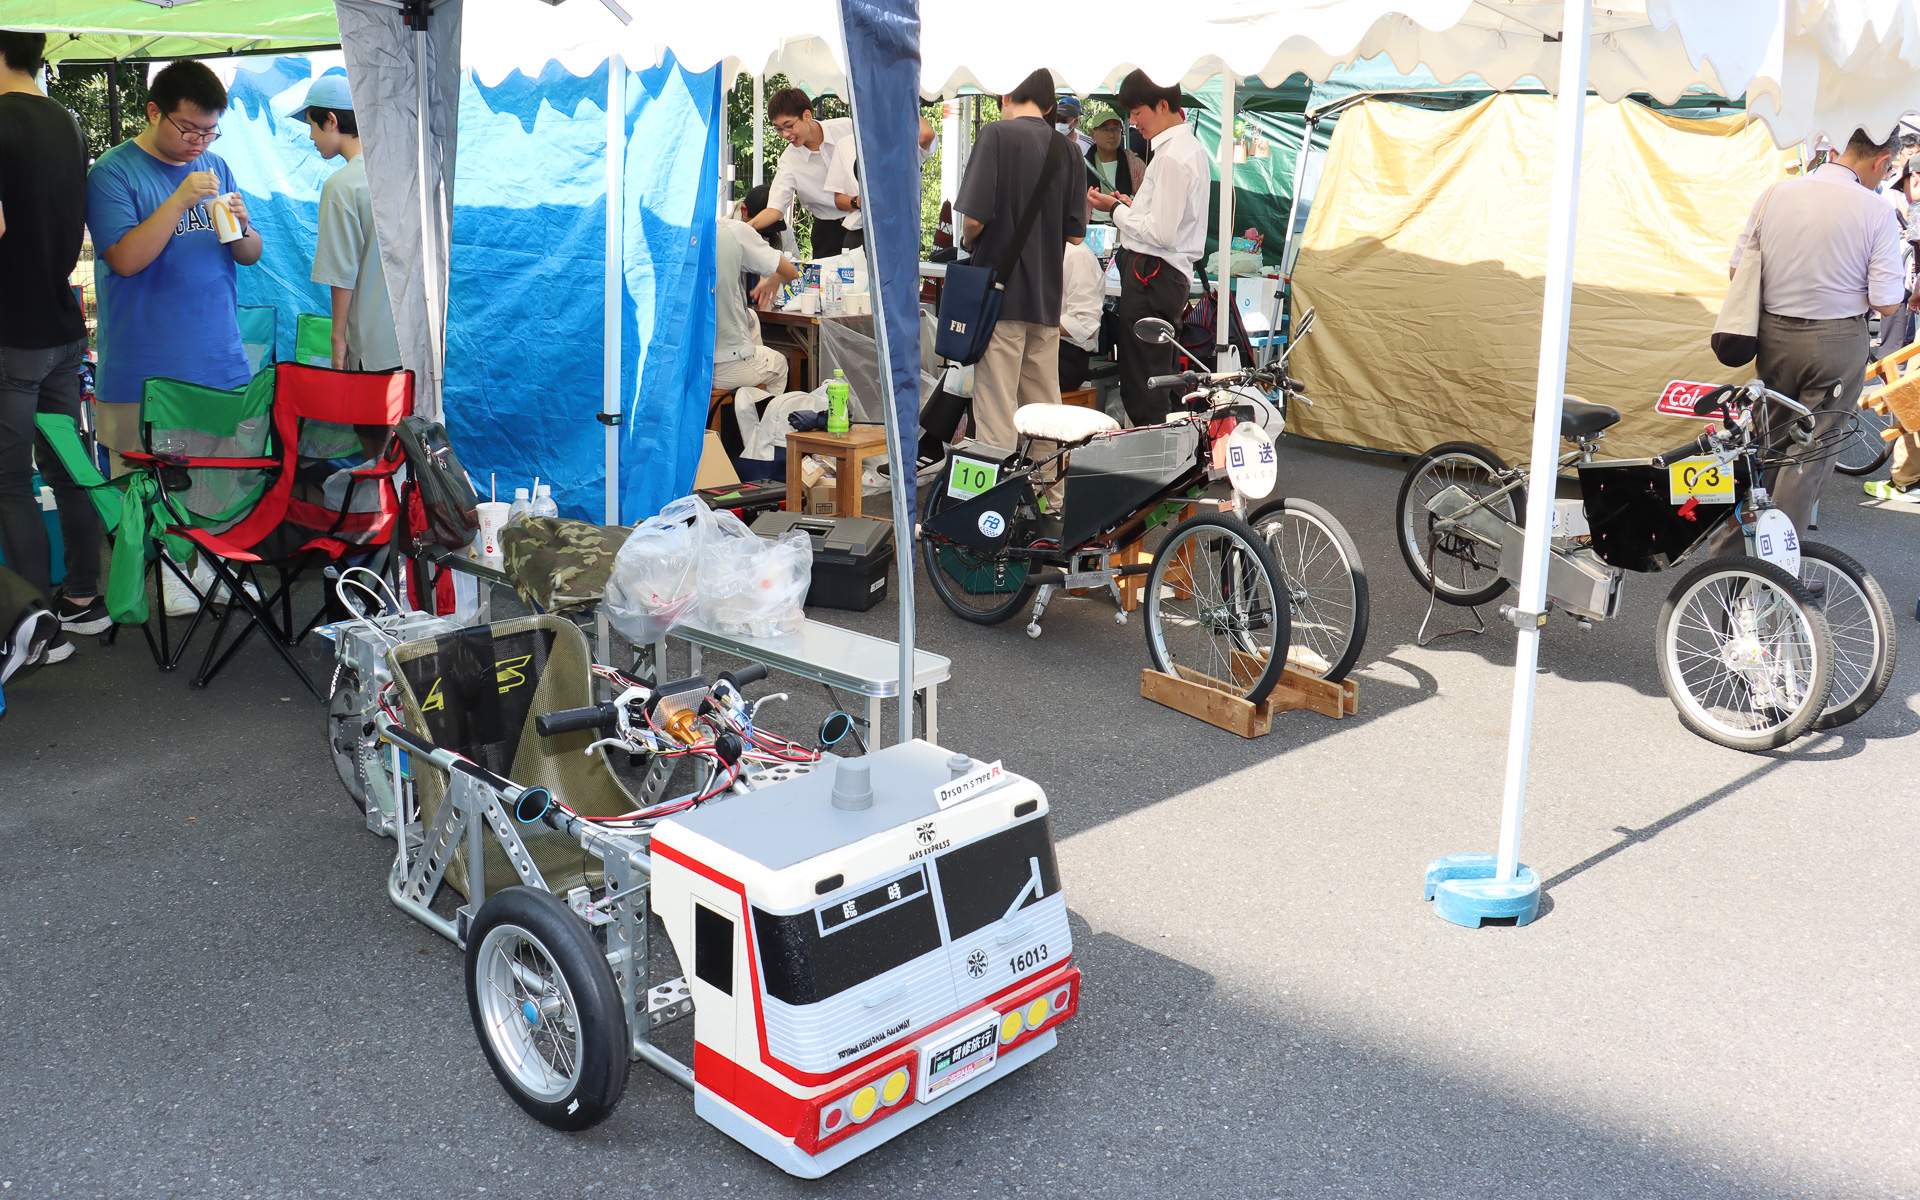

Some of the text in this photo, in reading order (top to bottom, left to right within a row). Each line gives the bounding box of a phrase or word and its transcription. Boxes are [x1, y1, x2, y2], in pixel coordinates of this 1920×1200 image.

[949, 319, 967, 334] FBI
[1229, 441, 1274, 468] 回送
[962, 467, 986, 489] 10
[1683, 466, 1720, 488] 03
[1759, 528, 1798, 557] 回送
[991, 766, 1001, 778] R
[908, 838, 951, 862] ALPS EXPRESS
[842, 882, 902, 919] 臨時
[1009, 943, 1048, 975] 16013
[859, 1032, 886, 1051] REGIONAL
[886, 1019, 910, 1037] RAILWAY
